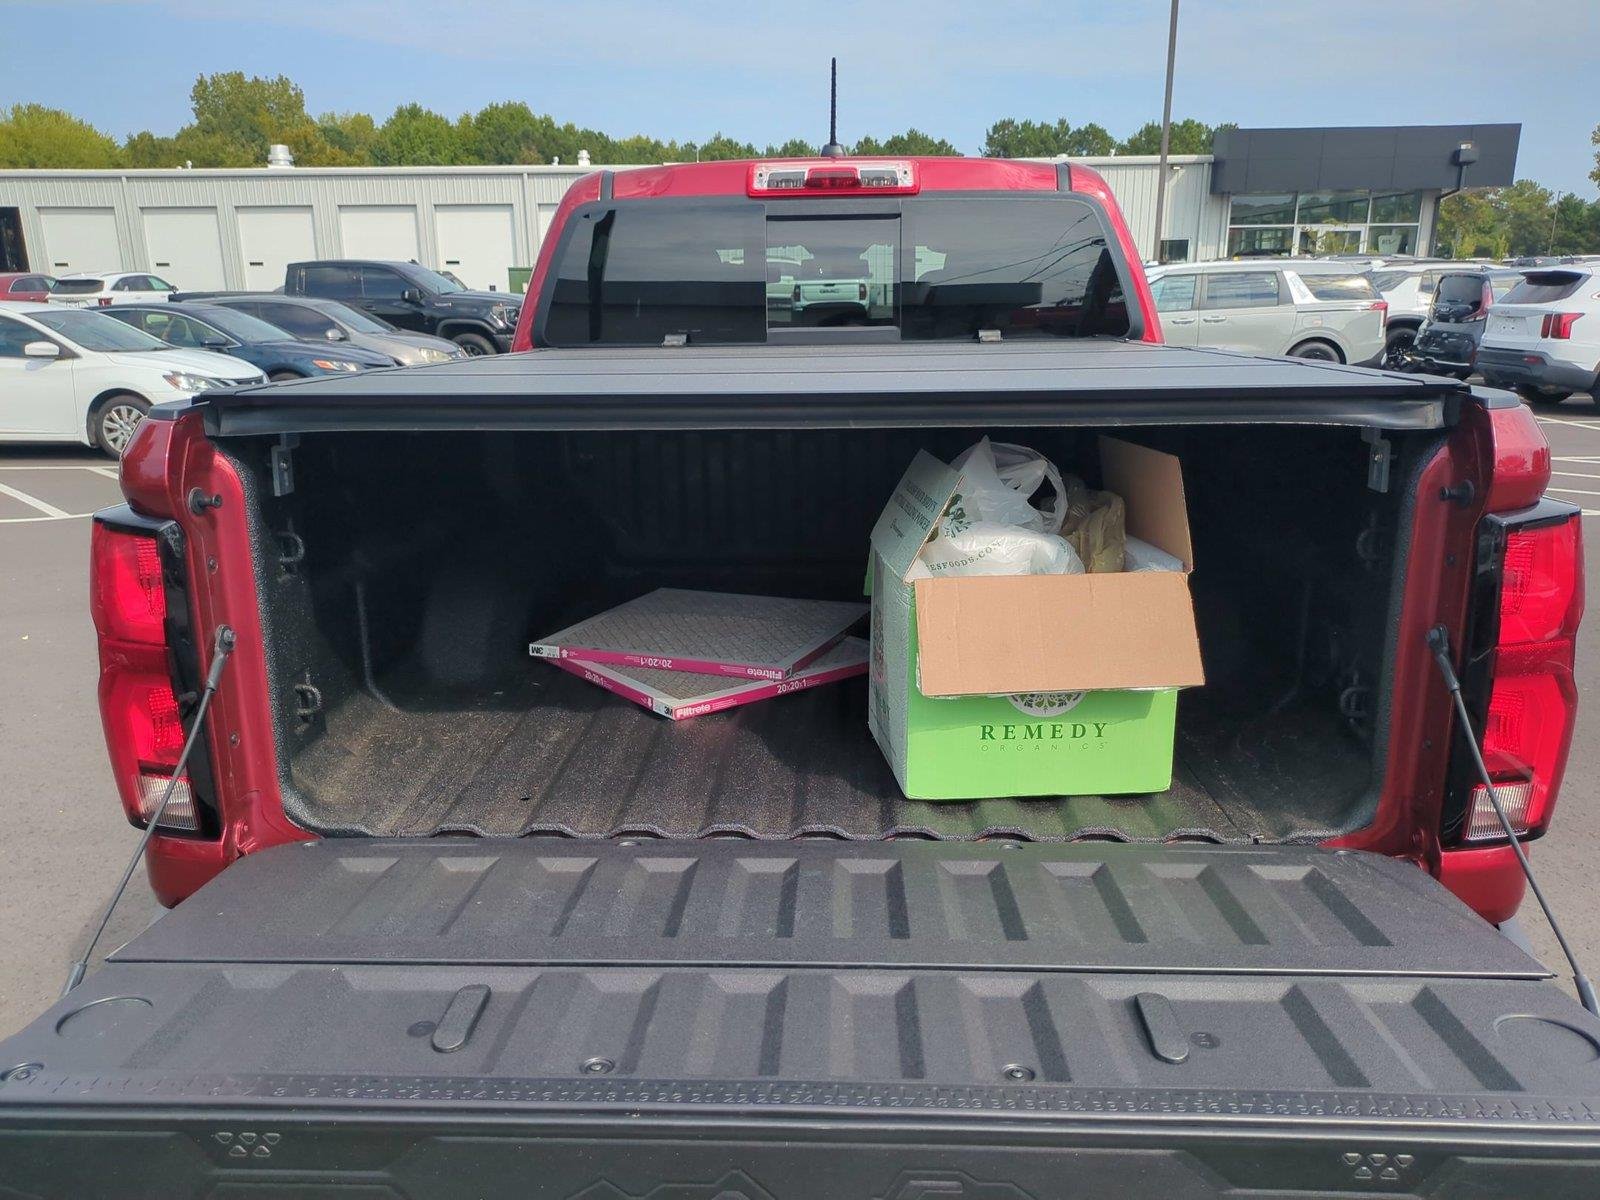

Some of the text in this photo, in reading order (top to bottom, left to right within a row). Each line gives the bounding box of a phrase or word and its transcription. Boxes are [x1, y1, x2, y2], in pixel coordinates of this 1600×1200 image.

[531, 646, 544, 655] 3M
[746, 667, 783, 680] Filtrete
[777, 678, 807, 694] 20x20x1
[675, 704, 711, 719] Filtrete
[980, 722, 1107, 741] REMEDY
[981, 743, 1108, 752] ORGANICS
